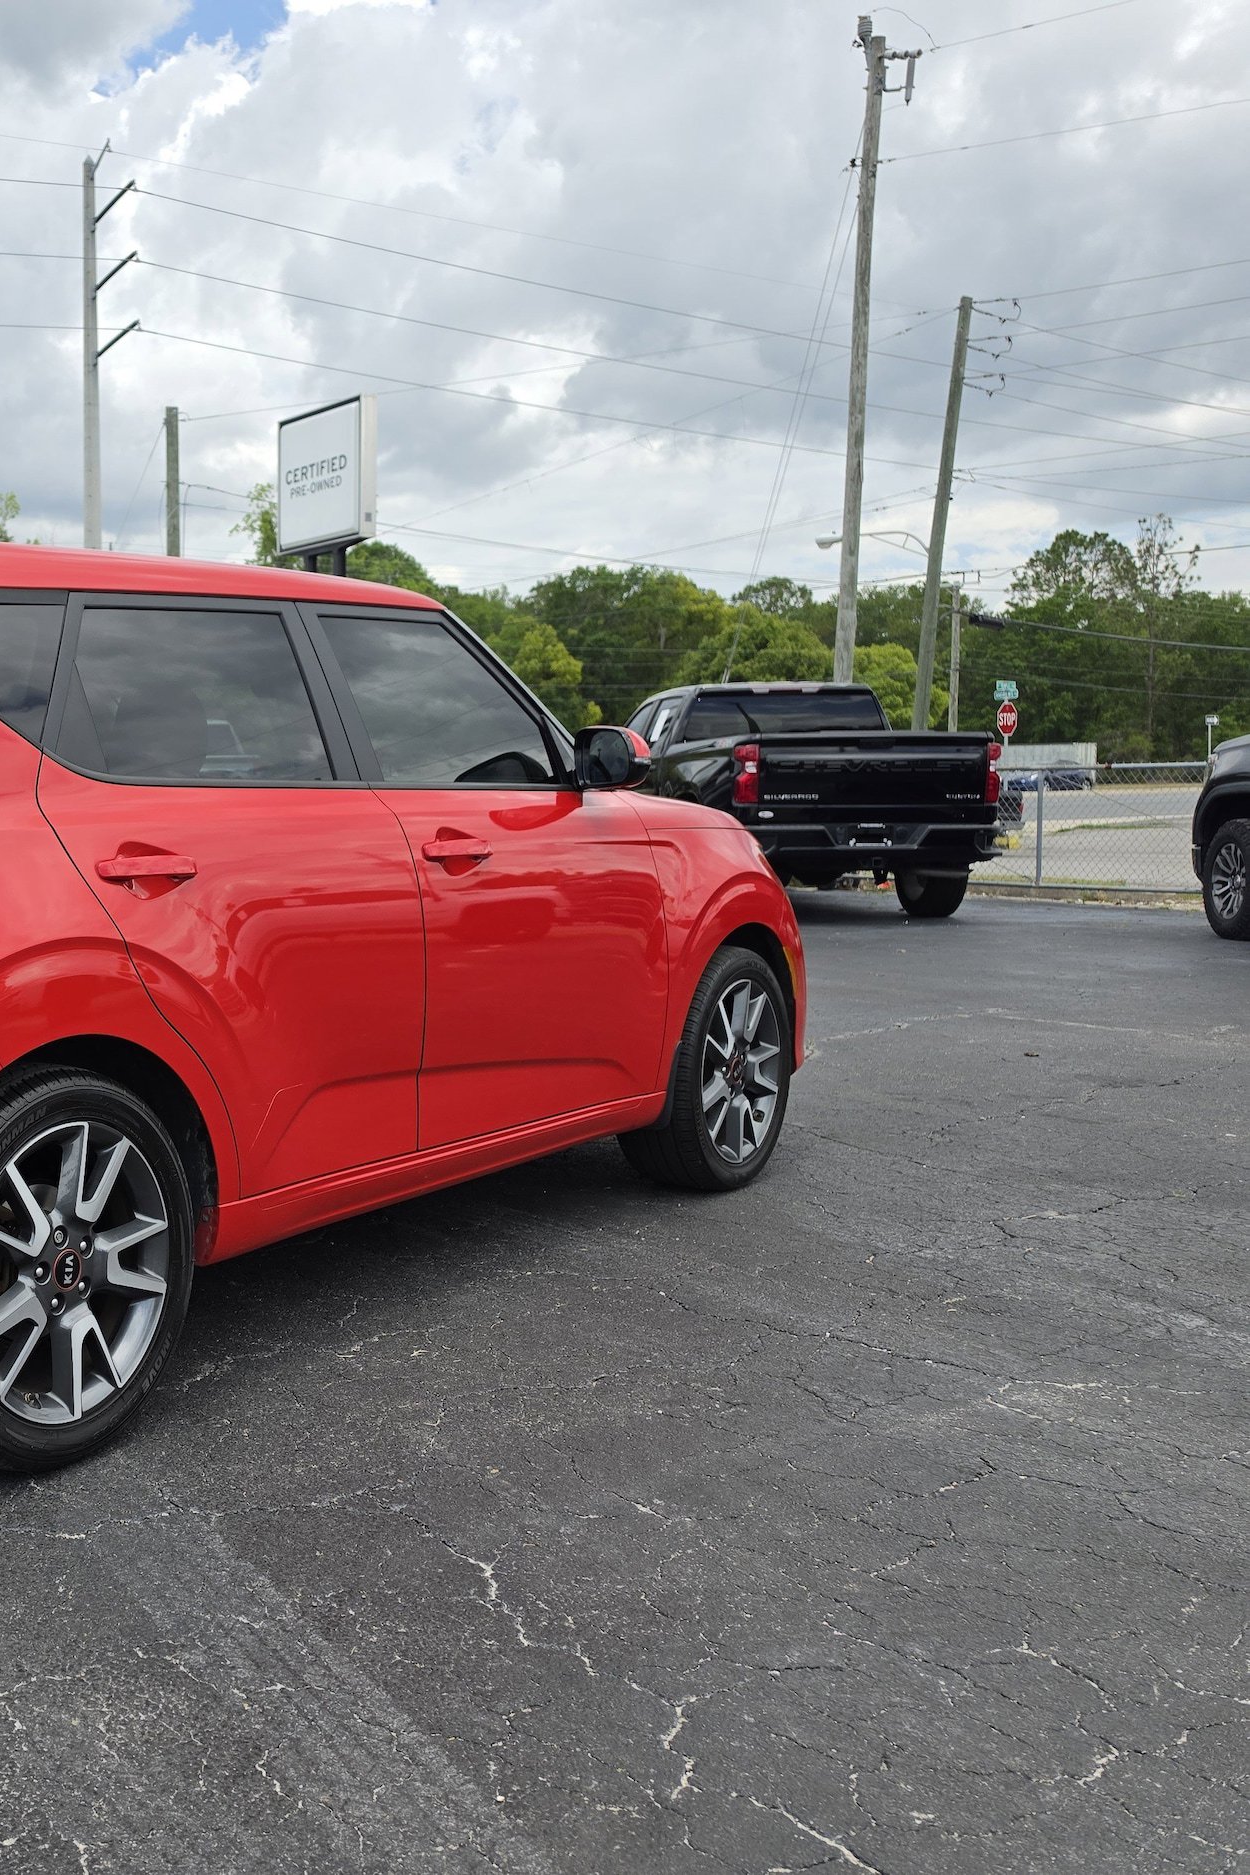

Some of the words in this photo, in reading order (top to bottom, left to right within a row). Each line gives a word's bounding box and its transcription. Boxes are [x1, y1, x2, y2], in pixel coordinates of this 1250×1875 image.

[286, 455, 347, 485] CERTIFIED
[290, 475, 342, 498] PRE-OWNED
[999, 712, 1016, 726] STOP
[763, 793, 820, 801] SILVERADO
[62, 1254, 75, 1285] KIA
